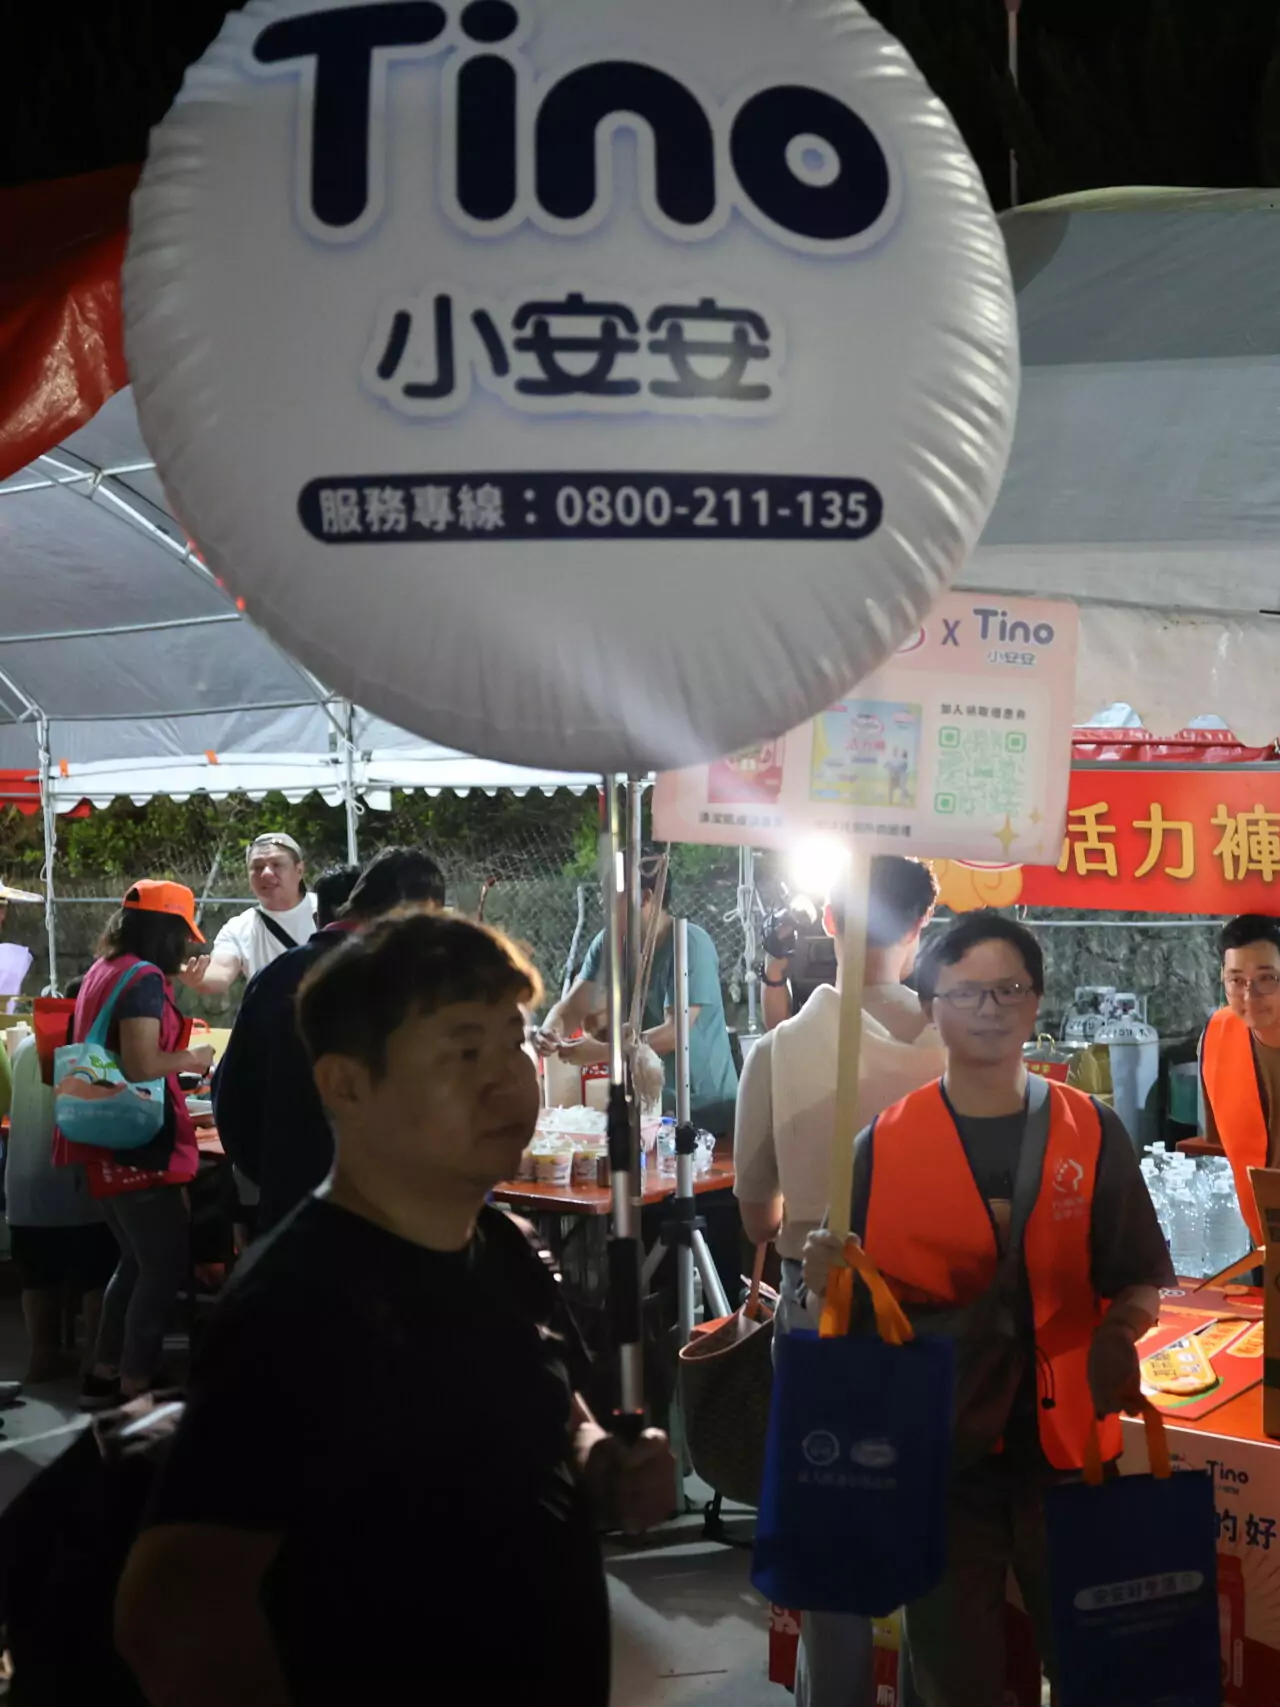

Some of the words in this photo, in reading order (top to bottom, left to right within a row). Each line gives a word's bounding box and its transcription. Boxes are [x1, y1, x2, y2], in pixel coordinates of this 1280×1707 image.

[252, 0, 890, 241] Tino
[376, 292, 772, 401] 小安安
[973, 609, 1054, 646] Tino
[1206, 1460, 1249, 1484] Tino
